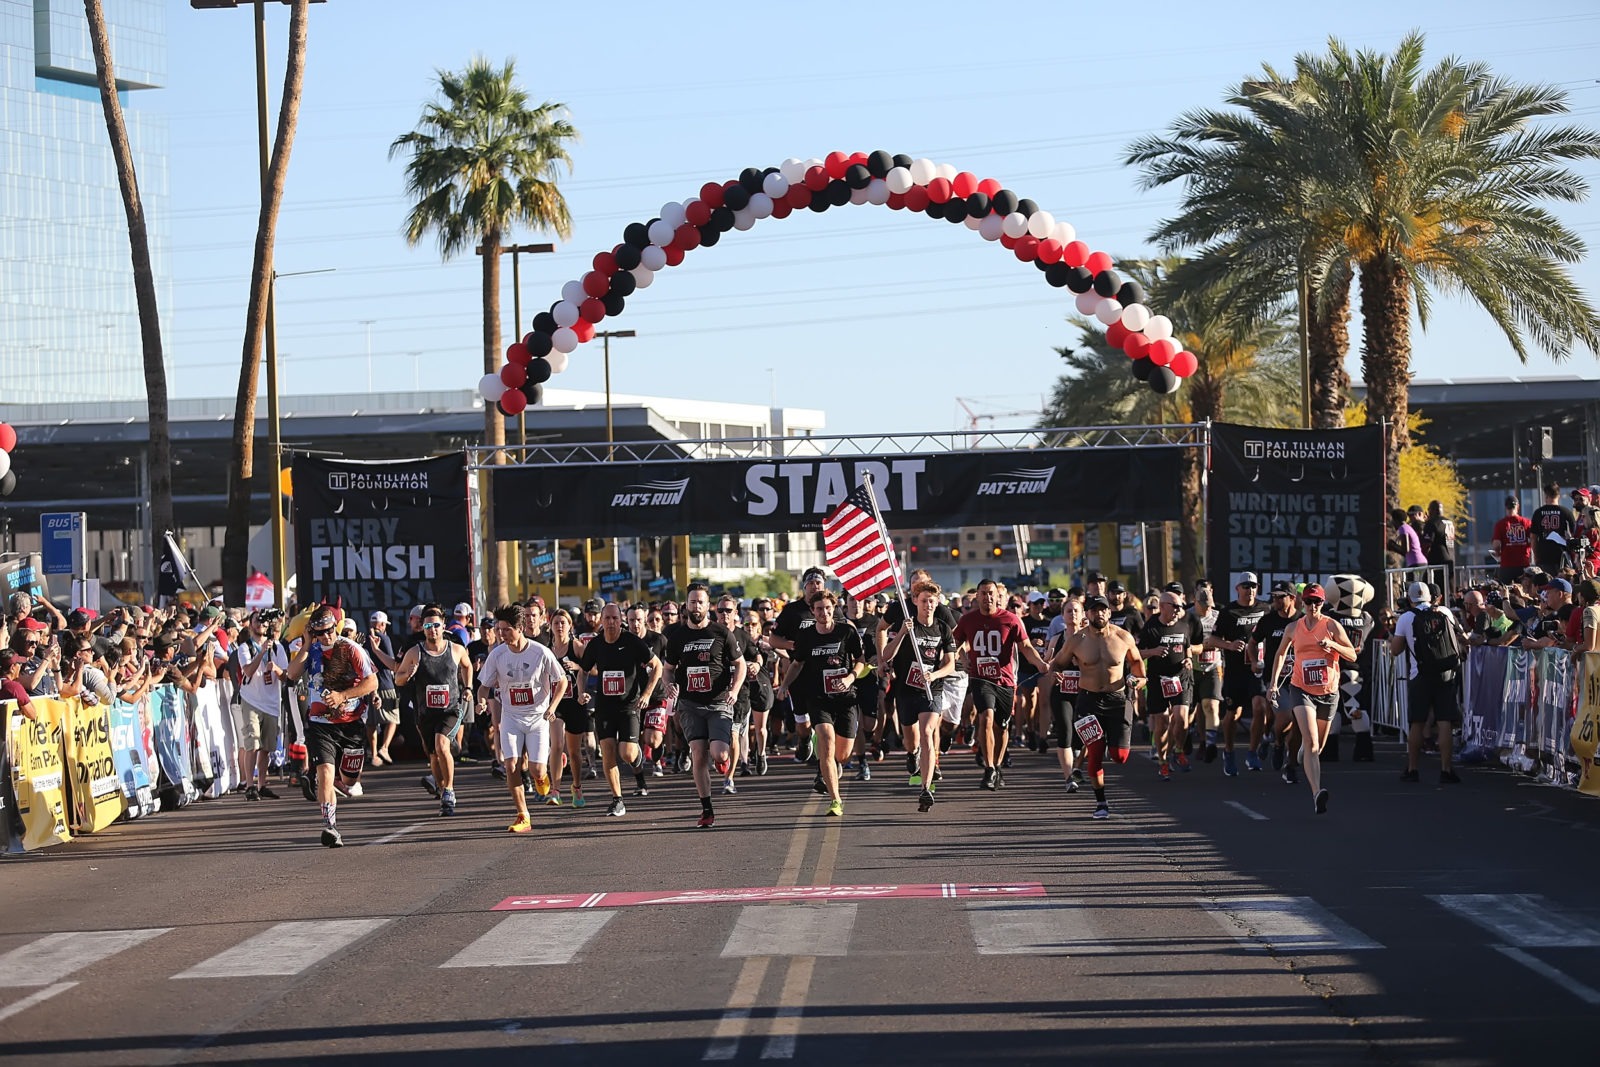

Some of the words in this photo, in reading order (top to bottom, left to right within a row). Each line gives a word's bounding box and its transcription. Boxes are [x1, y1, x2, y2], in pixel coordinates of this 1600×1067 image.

[1266, 441, 1287, 449] PAT
[1292, 441, 1344, 450] TILLMAN
[1266, 450, 1345, 459] FOUNDATION
[350, 472, 371, 481] PAT
[376, 472, 428, 481] TILLMAN
[351, 481, 428, 489] FOUNDATION
[745, 459, 926, 515] START
[976, 481, 1018, 496] PAT'S
[1016, 475, 1051, 494] RUN
[610, 493, 652, 507] PAT'S
[650, 486, 687, 506] RUN
[1229, 492, 1316, 513] WRITING
[1322, 494, 1361, 513] THE
[48, 518, 70, 528] BUS
[310, 517, 400, 544] EVERY
[1228, 513, 1301, 535] STORY
[1307, 514, 1337, 535] OF
[1342, 515, 1358, 535] A
[1541, 515, 1560, 529] 40
[311, 545, 436, 581] FINISH
[1229, 537, 1362, 571] BETTER
[384, 581, 413, 608] IS
[416, 580, 435, 603] A
[972, 630, 1002, 656] 40
[691, 676, 706, 688] 1212
[1064, 679, 1078, 690] 1234
[1308, 669, 1323, 681] 1015
